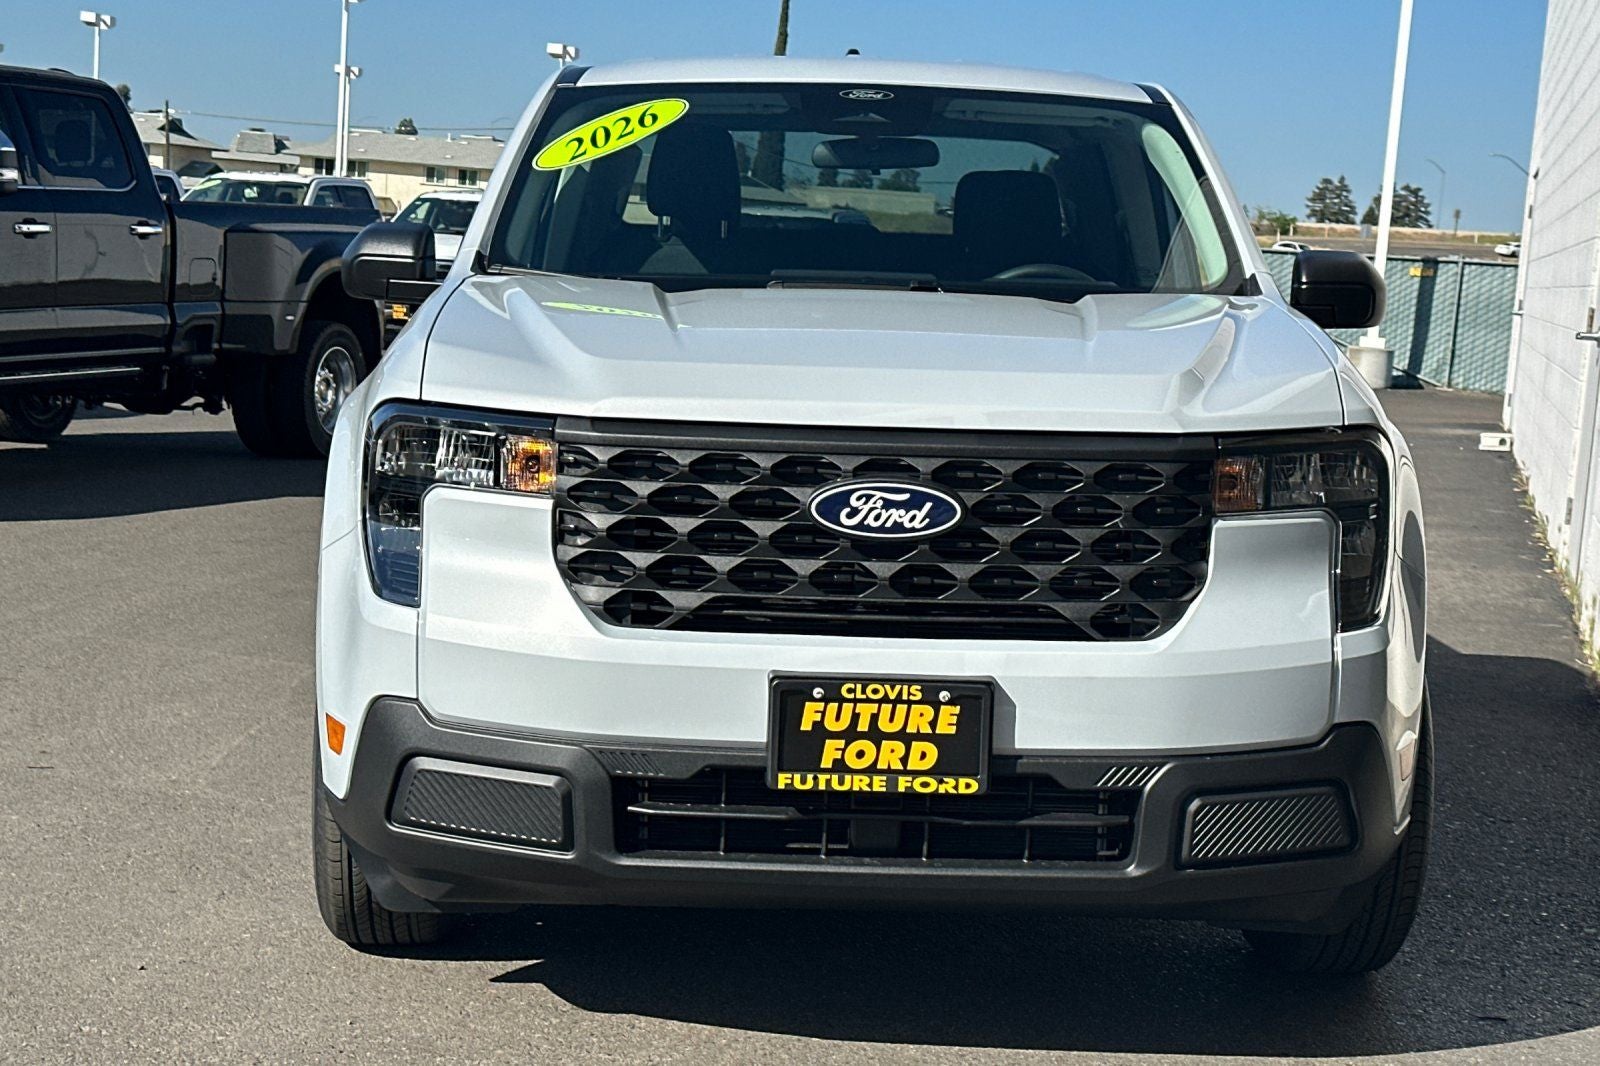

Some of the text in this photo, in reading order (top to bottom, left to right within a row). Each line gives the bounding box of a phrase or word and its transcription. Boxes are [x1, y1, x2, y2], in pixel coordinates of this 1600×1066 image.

[849, 90, 884, 99] Ford
[565, 105, 659, 162] 2026
[840, 490, 933, 529] Ford
[841, 683, 923, 701] CLOVIS
[800, 701, 961, 735] FUTURE
[820, 739, 939, 771] FORD
[777, 773, 979, 794] FUTURE FORD
